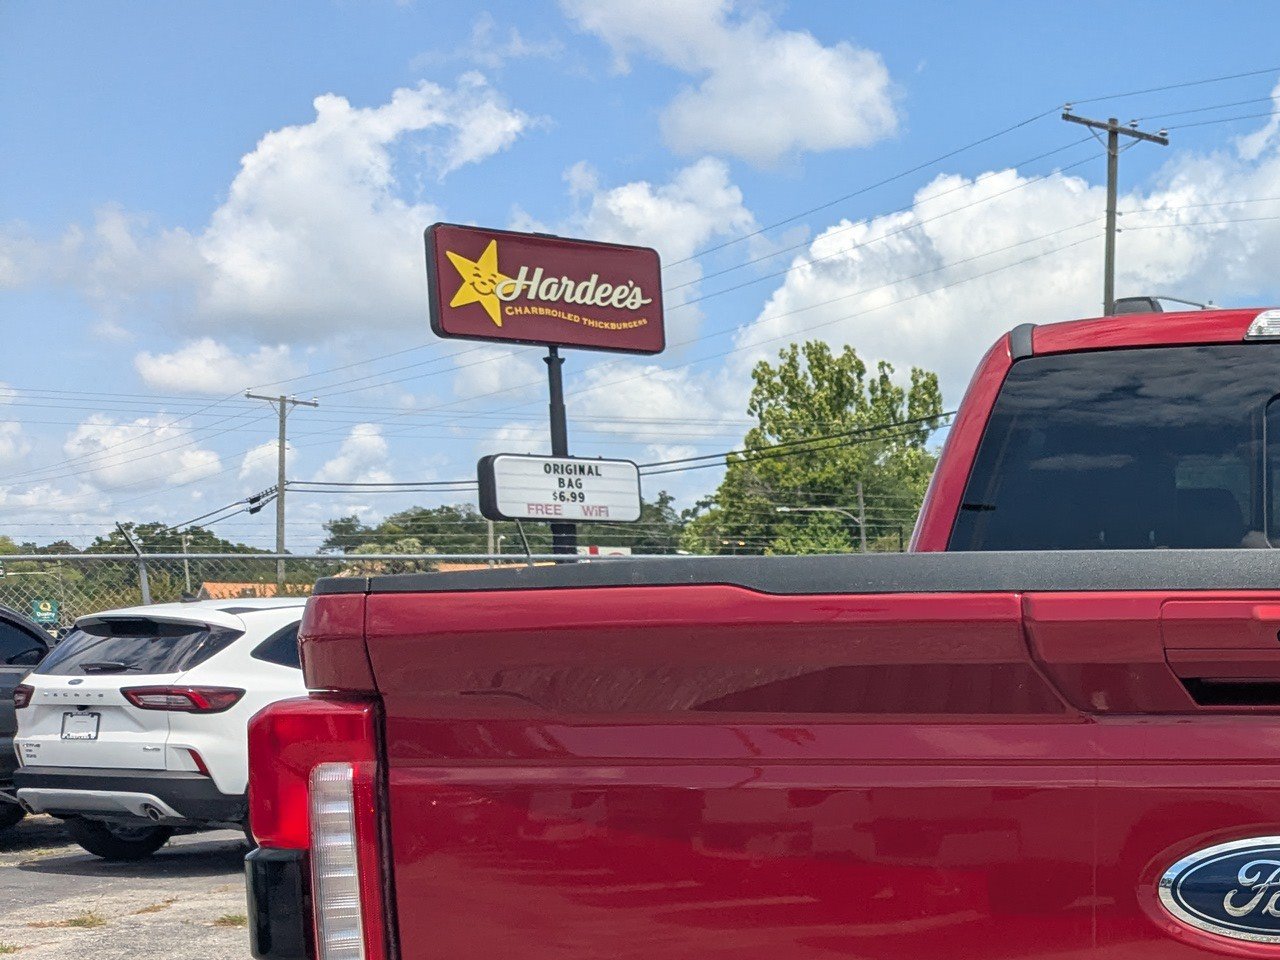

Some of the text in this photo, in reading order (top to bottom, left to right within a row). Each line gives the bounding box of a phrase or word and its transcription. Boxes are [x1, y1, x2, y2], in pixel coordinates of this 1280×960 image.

[495, 265, 653, 310] Hardee's
[504, 305, 648, 330] CHARBROILED THICKBURGERS
[543, 462, 603, 477] ORIGINAL
[558, 477, 583, 490] BAG
[552, 490, 586, 503] $6.99
[526, 502, 563, 516] FREE
